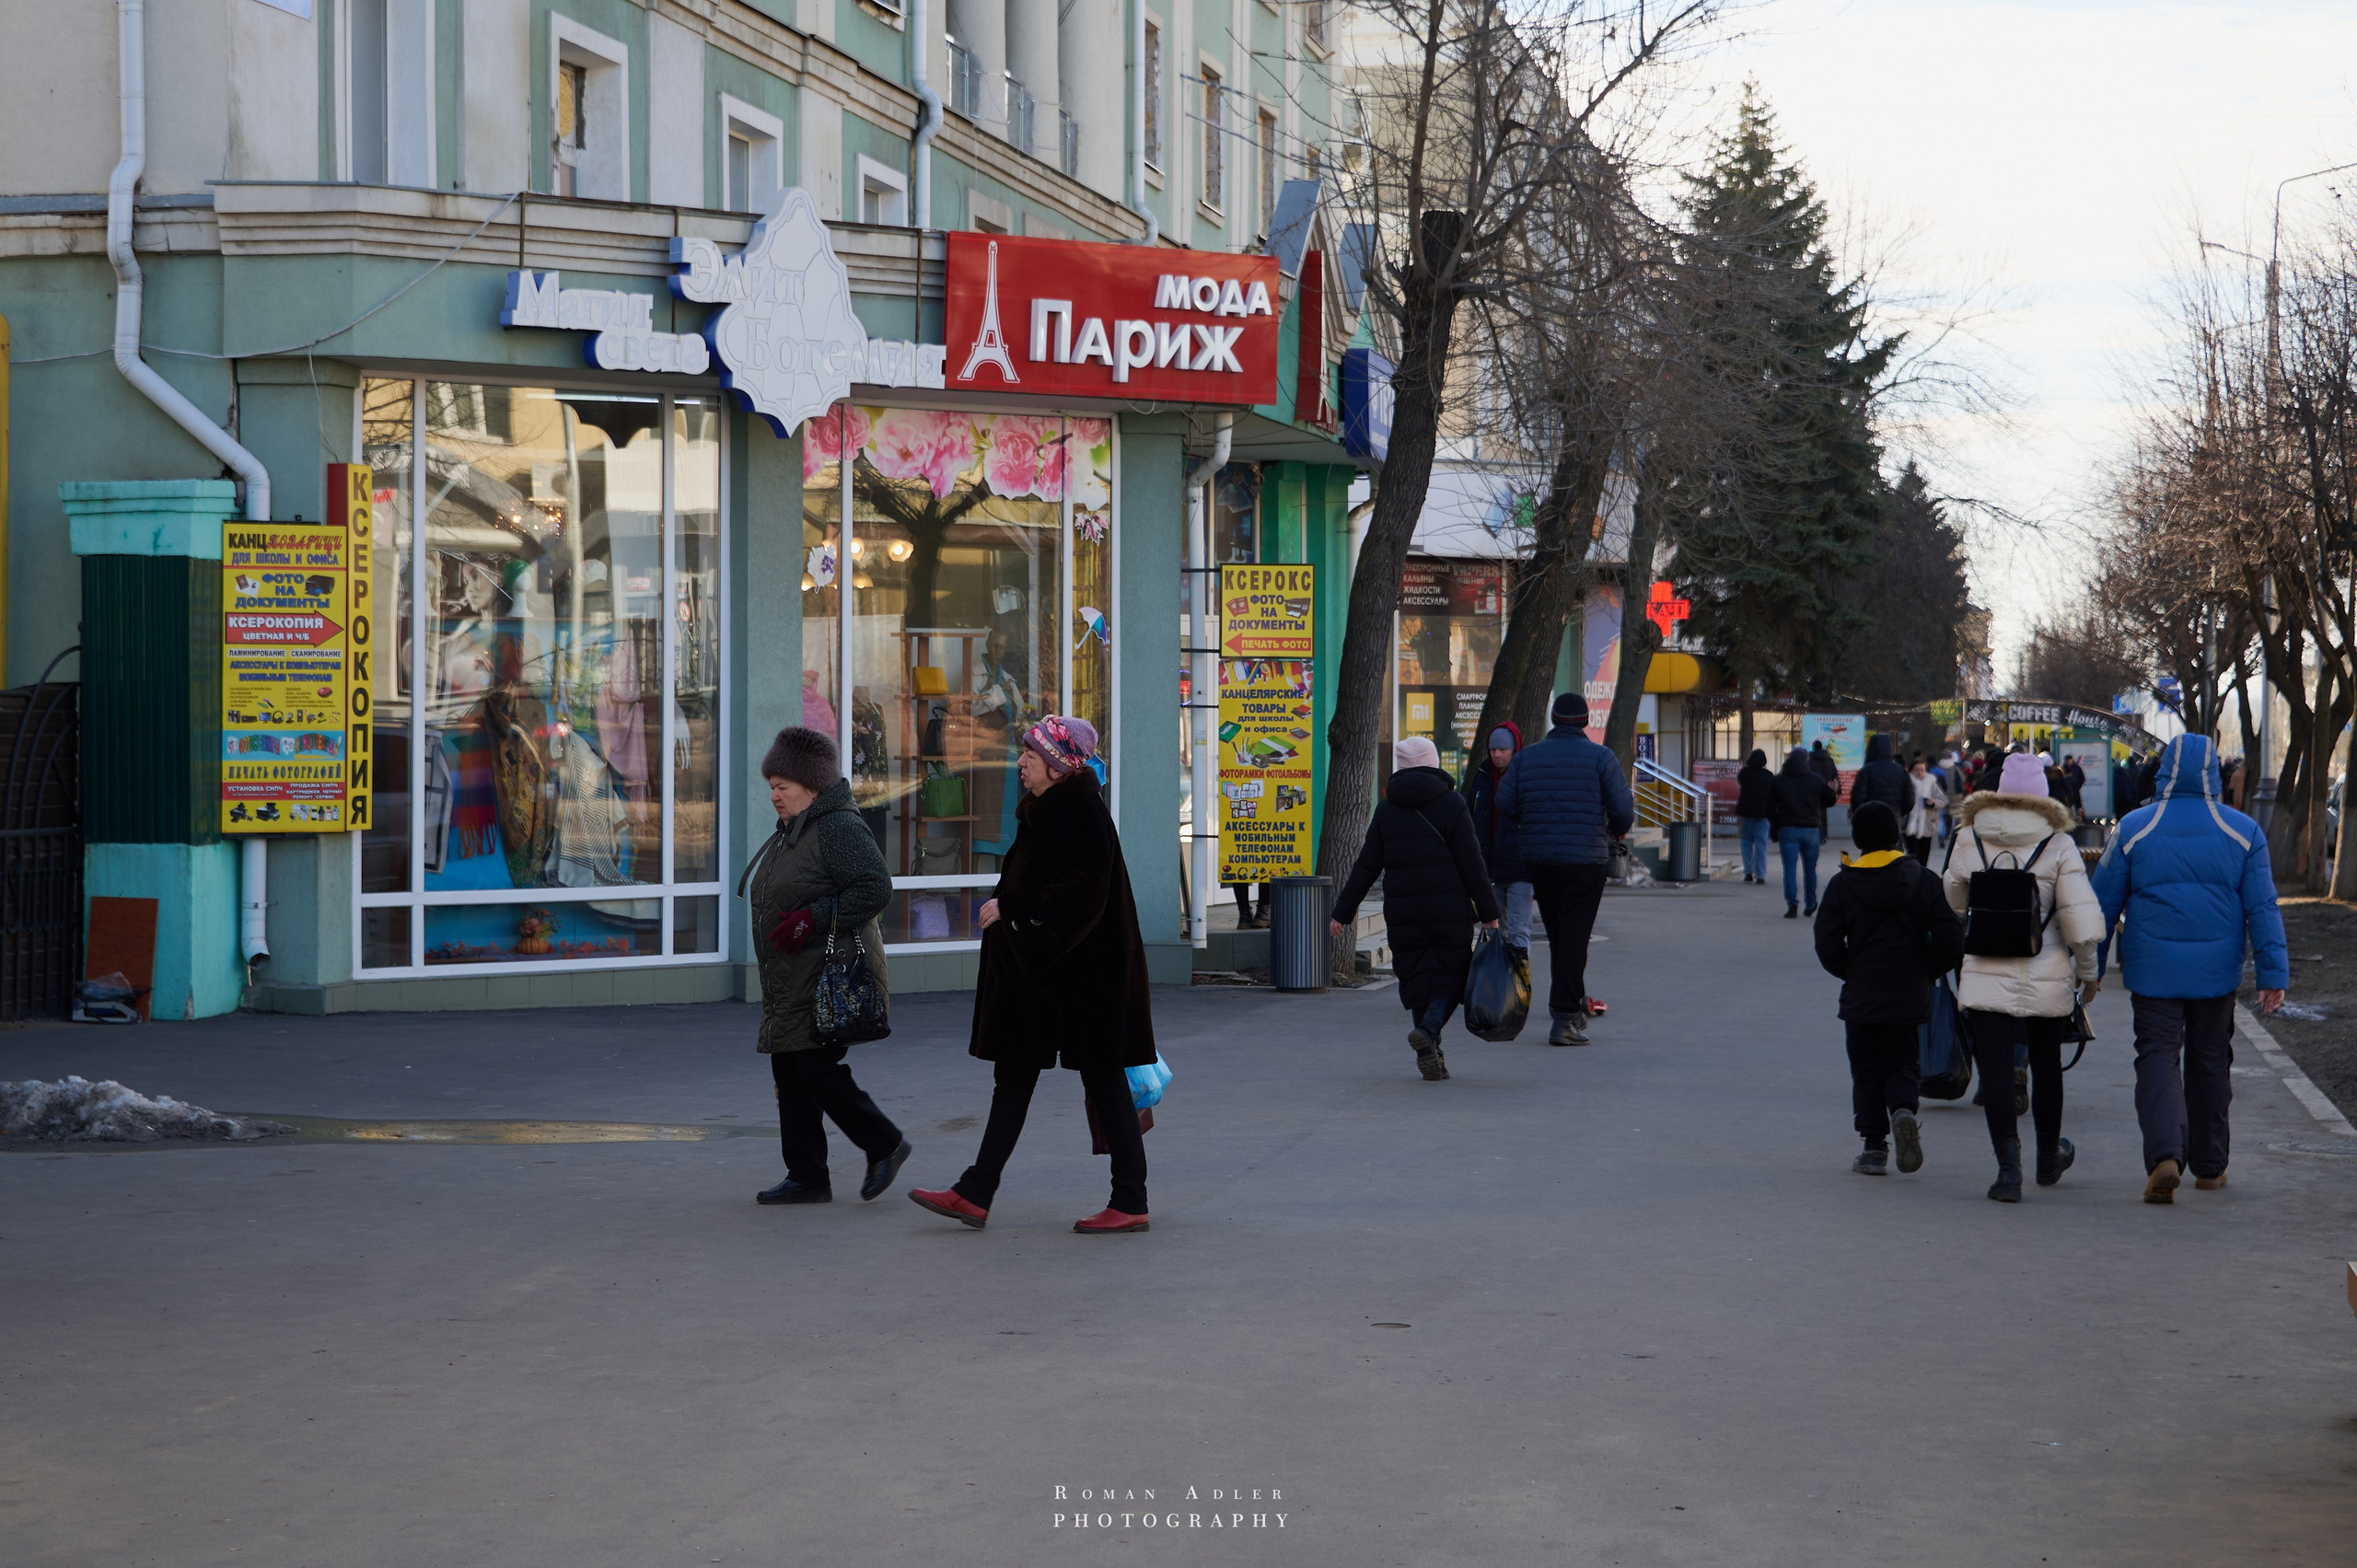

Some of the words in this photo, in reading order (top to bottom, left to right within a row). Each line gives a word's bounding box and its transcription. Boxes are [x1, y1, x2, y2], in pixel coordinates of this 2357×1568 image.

[680, 238, 806, 304] Элит
[511, 269, 654, 331] Магия
[596, 331, 709, 373] света
[744, 319, 946, 389] Богемия
[232, 552, 250, 565] ДЛЯ
[256, 552, 291, 564] ШКОЛЫ
[296, 552, 302, 564] И
[307, 553, 339, 565] ОФИСА
[1403, 563, 1450, 573] ЭЛЕКТРОННЫЕ
[261, 574, 304, 585] ФОТО
[1225, 570, 1311, 591] КСЕРОКС
[1402, 575, 1434, 584] КАЛЬЯНЫ
[275, 586, 296, 596] НА
[1402, 586, 1440, 595] ЖИДКОСТИ
[235, 597, 330, 610] ДОКУМЕНТЫ
[1249, 594, 1284, 605] ФОТО
[1402, 597, 1448, 606] АКСЕССУАРЫ
[1260, 608, 1277, 618] НА
[228, 617, 324, 629] КСЕРОКОПИЯ
[1228, 620, 1306, 632] ДОКУМЕНТЫ
[243, 633, 284, 641] ЦВЕТНАЯ
[296, 633, 310, 641] Ч/Б
[351, 472, 369, 825] КСЕРОКОПИЯ
[1241, 640, 1280, 649] ПЕЧАТЬ
[1282, 640, 1309, 649] ФОТО
[1222, 689, 1305, 701] КАНЦЕЛЯРСКИЕ
[1242, 703, 1286, 714] ТОВАРЫ
[2008, 703, 2061, 724] COFFEE
[228, 765, 269, 779] ПЕЧАТЬ
[273, 763, 342, 779] ФОТОГРАФИЙ
[1219, 769, 1265, 779] ФОТОРАМКИ
[1266, 769, 1312, 779] ФОТОАЛЬБОМЫ
[1225, 821, 1295, 831] АКСЕССУАРЫ
[1298, 821, 1306, 831] К
[1234, 833, 1296, 842] МОБИЛЬНЫМ
[1236, 844, 1294, 854] ТЕЛЕФОНАМ
[1228, 854, 1301, 865] КОМПЬЮТЕРАМ
